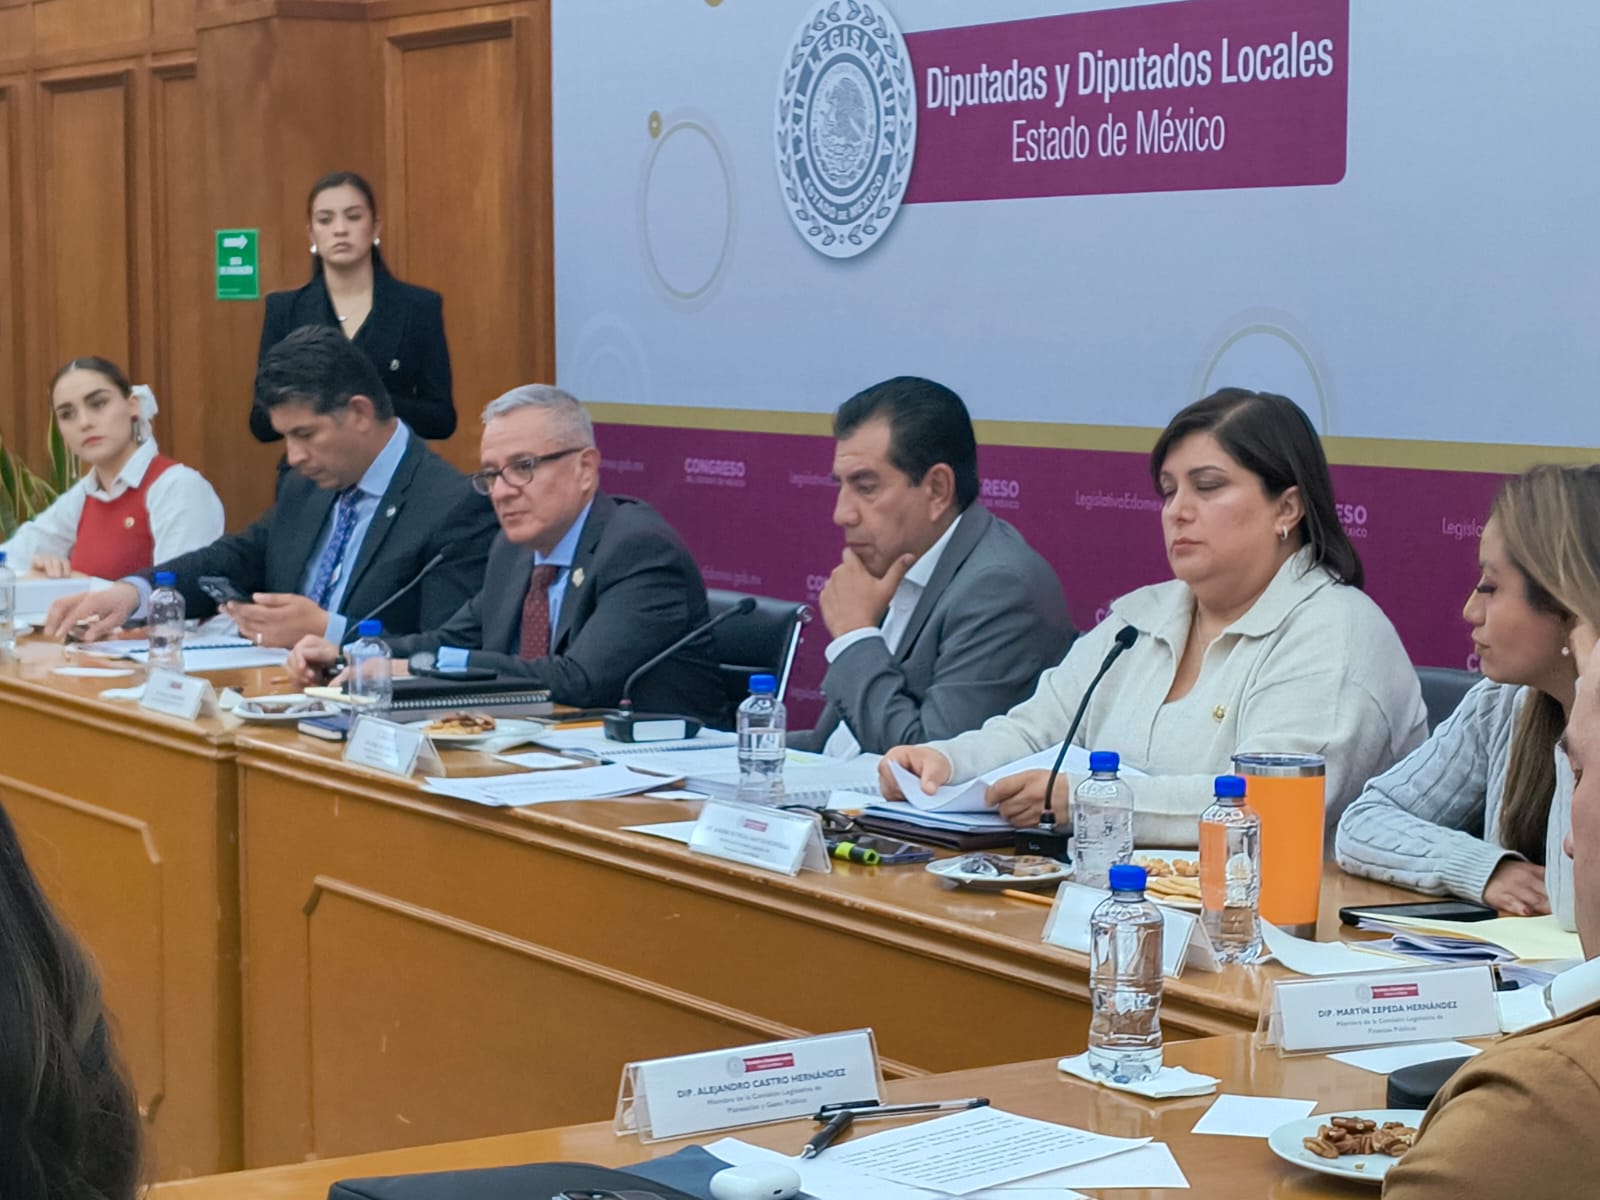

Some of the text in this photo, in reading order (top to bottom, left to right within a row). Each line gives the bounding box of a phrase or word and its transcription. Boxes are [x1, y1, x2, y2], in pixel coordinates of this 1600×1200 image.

[926, 31, 1334, 116] Diputadas y Diputados Locales
[1012, 106, 1226, 162] Estado de México
[684, 457, 746, 478] CONGRESO
[982, 478, 1020, 498] RESO
[1075, 489, 1162, 511] LegislativoEdome
[1336, 1006, 1370, 1016] MARTÍN
[1372, 1004, 1405, 1015] ZEPEDA
[1406, 1000, 1458, 1012] HERNÁNDEZ
[677, 1068, 847, 1099] DIP. ALEJANDRO CASTRO HERNÁNDEZ
